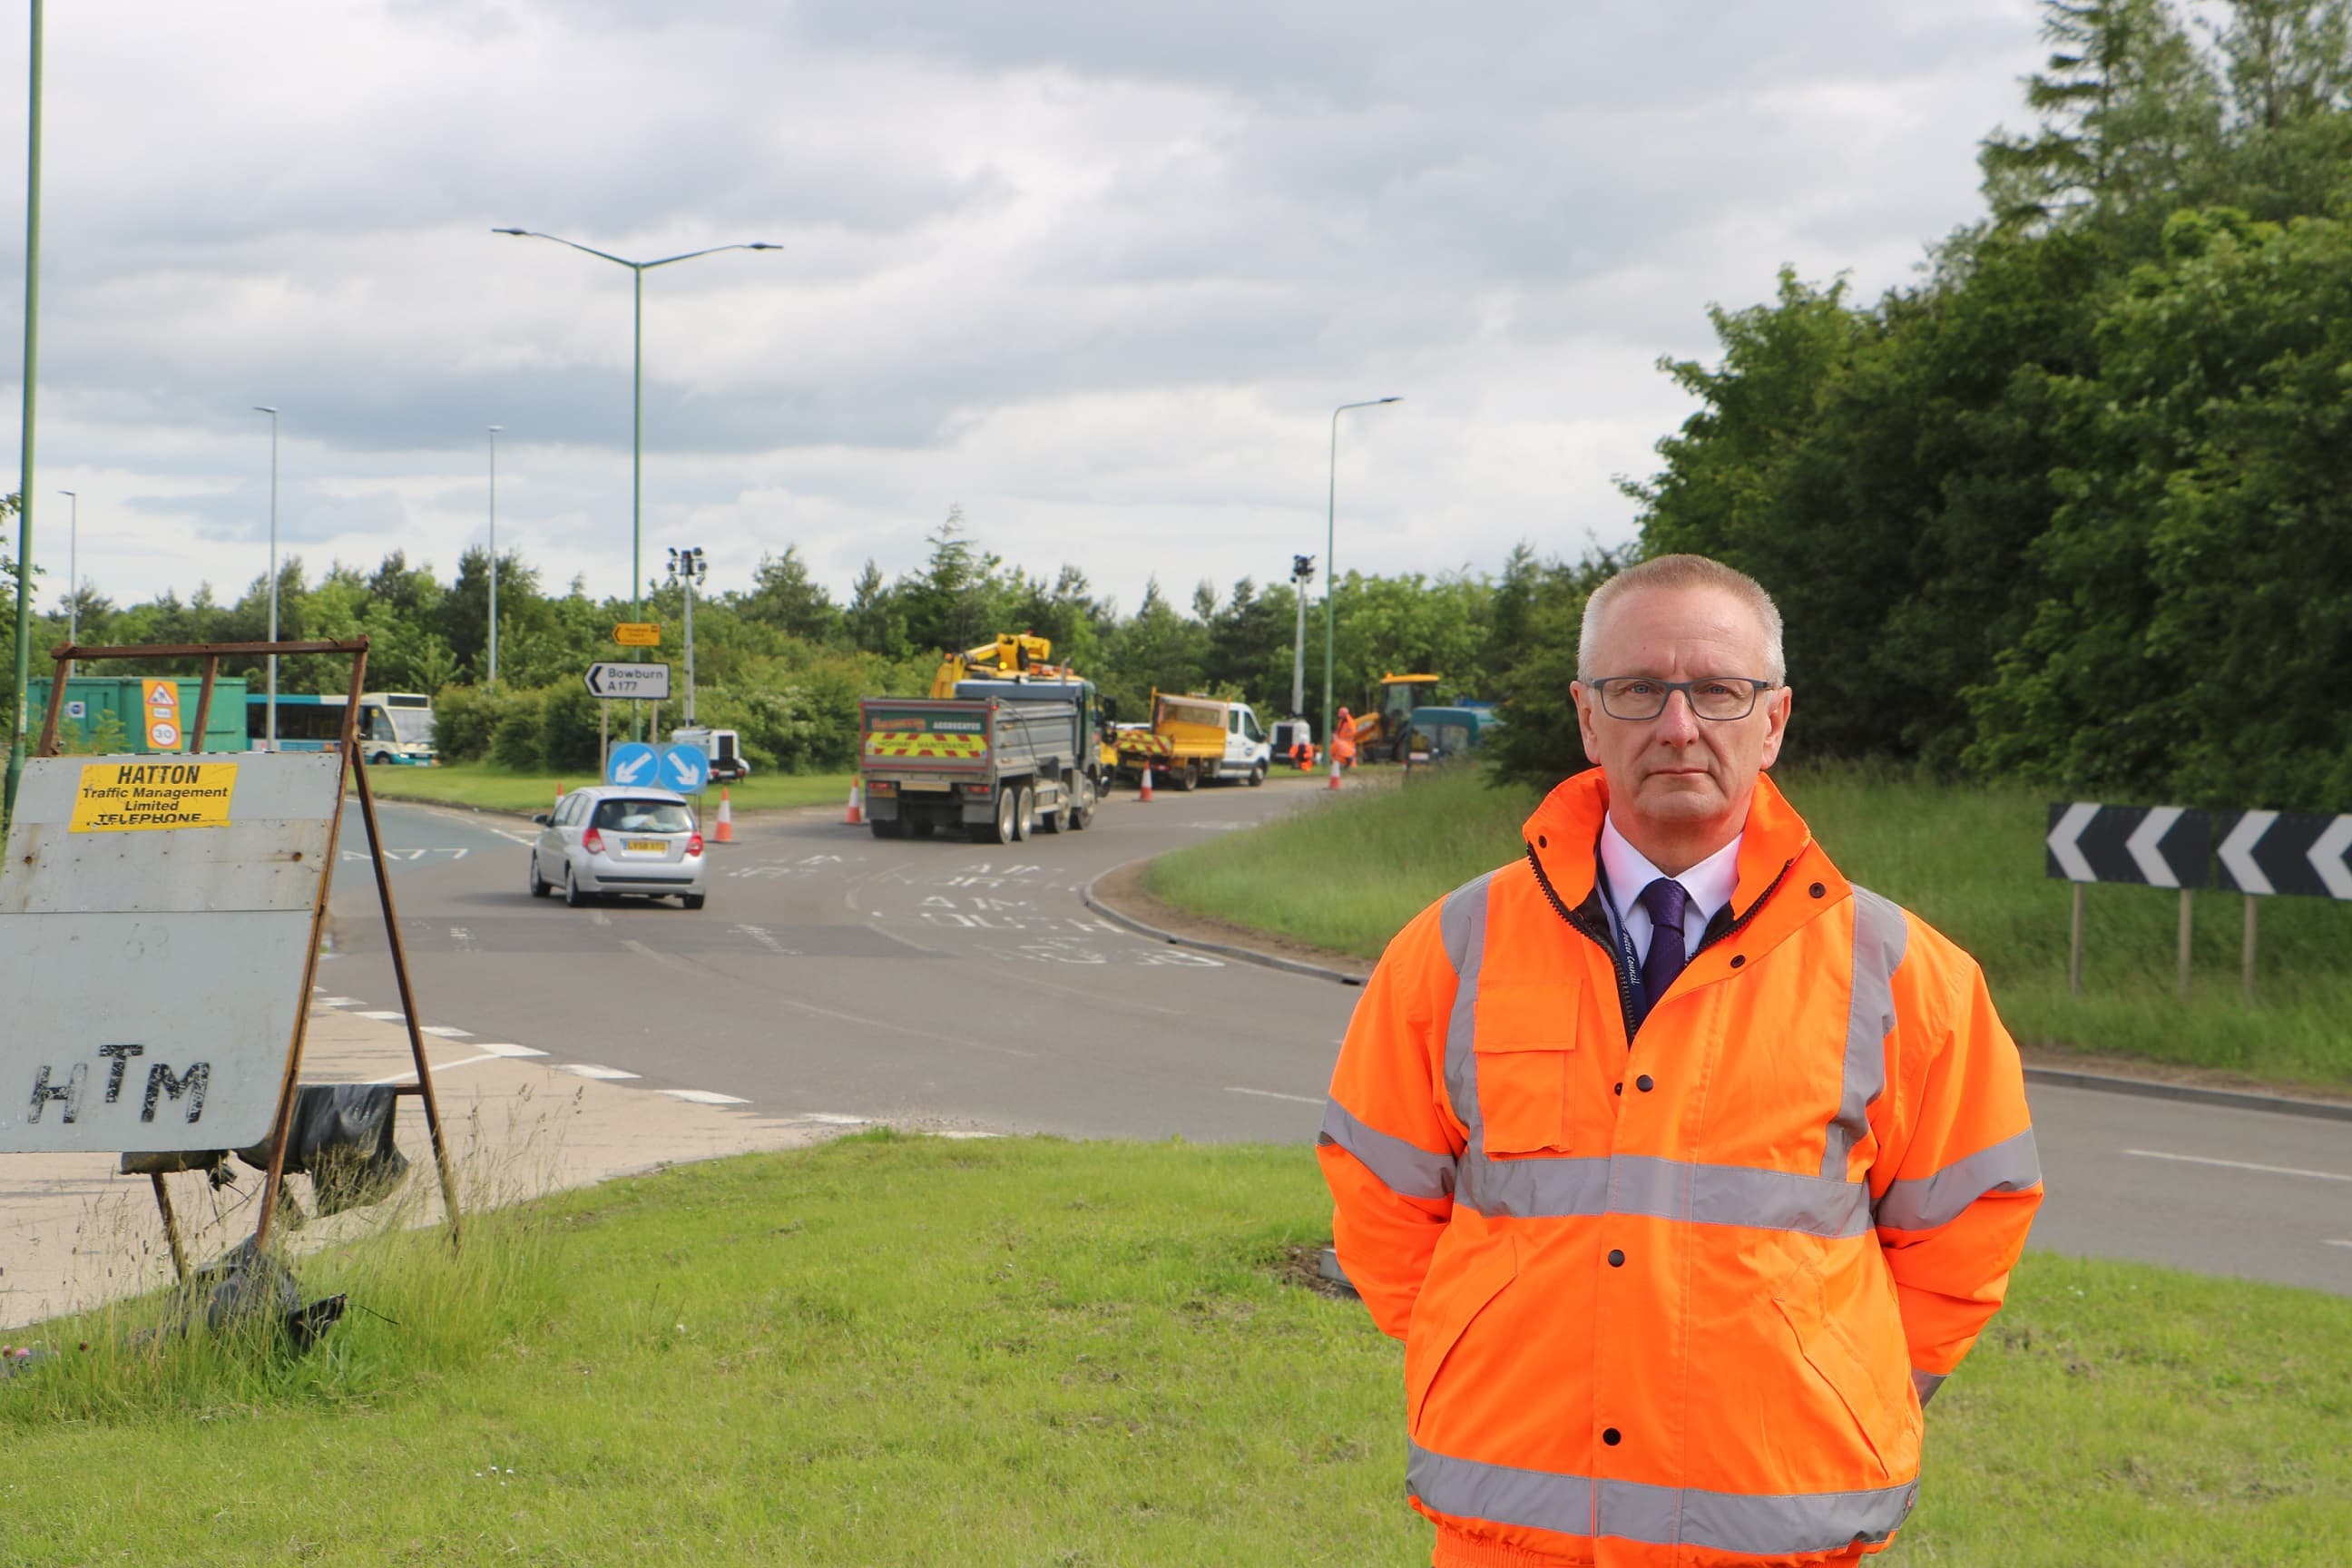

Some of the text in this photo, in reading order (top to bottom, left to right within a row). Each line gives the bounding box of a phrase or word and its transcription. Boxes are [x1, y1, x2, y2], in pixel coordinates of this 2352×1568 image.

[608, 668, 662, 679] Bowburn
[154, 729, 172, 740] 30
[117, 765, 201, 784] HATTON
[83, 788, 229, 799] Traffic Management
[124, 800, 180, 811] Limited
[97, 813, 201, 825] TELEPHONE
[1627, 956, 1641, 986] Council
[27, 1044, 210, 1123] HTM
